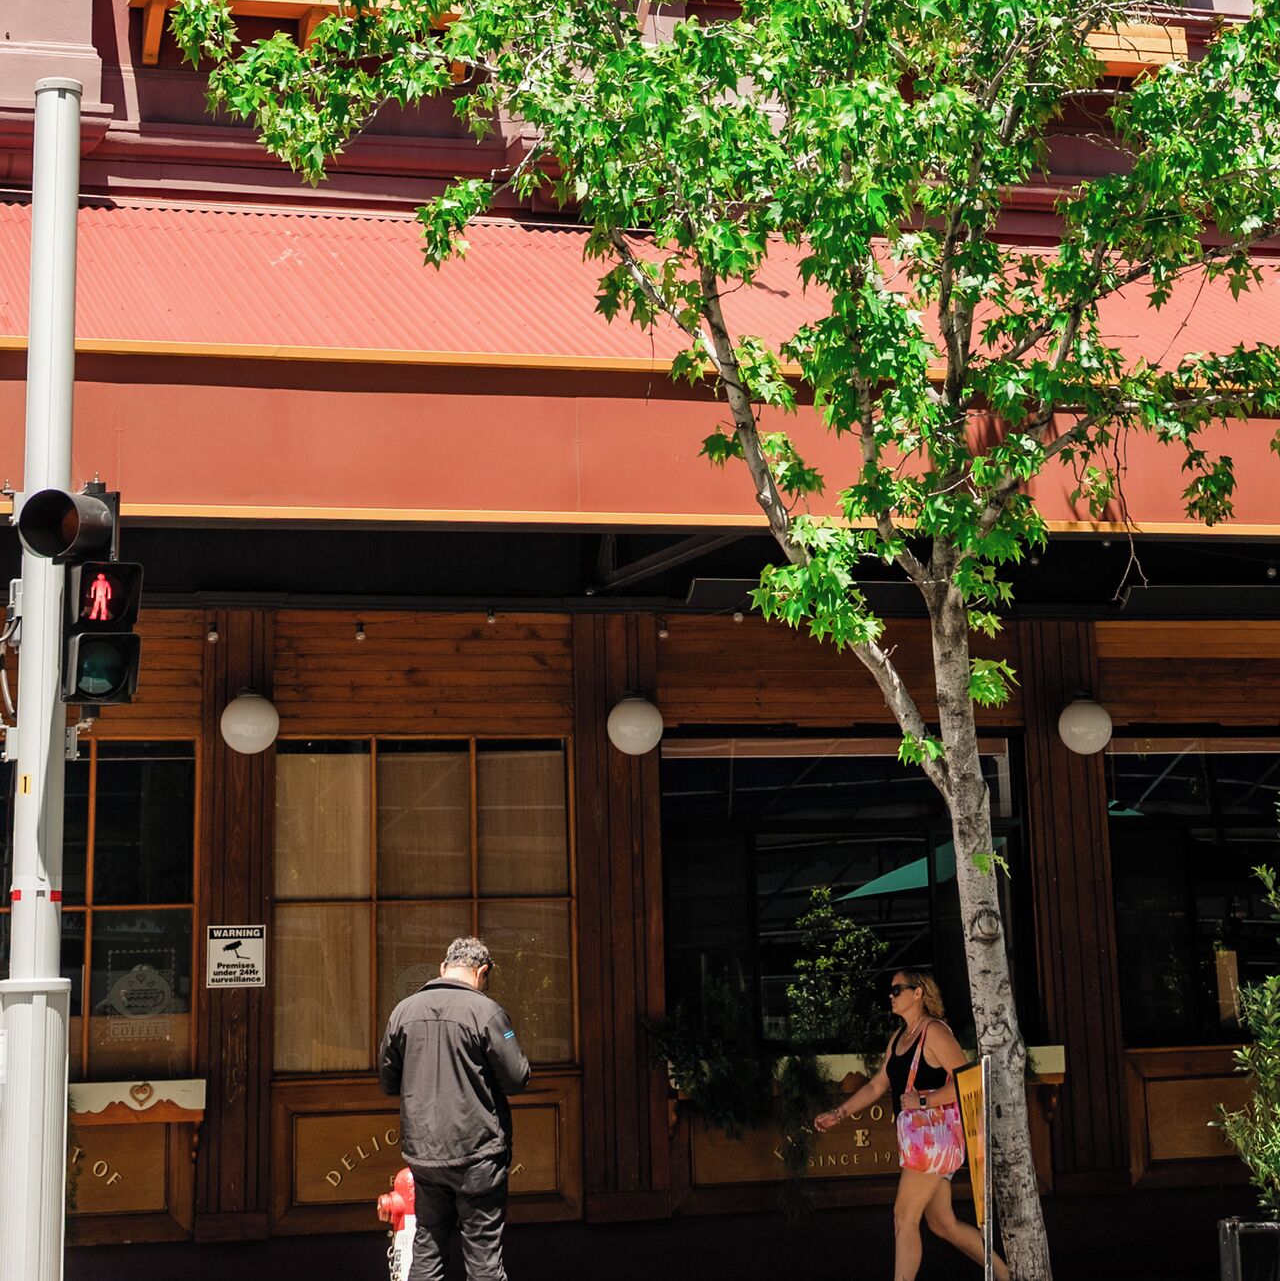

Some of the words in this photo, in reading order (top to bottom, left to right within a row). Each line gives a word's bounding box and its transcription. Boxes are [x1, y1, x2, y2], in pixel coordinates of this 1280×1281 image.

[213, 929, 261, 938] WARNING
[217, 961, 255, 969] Premises
[808, 1152, 861, 1167] SINCE
[92, 1159, 122, 1186] OF
